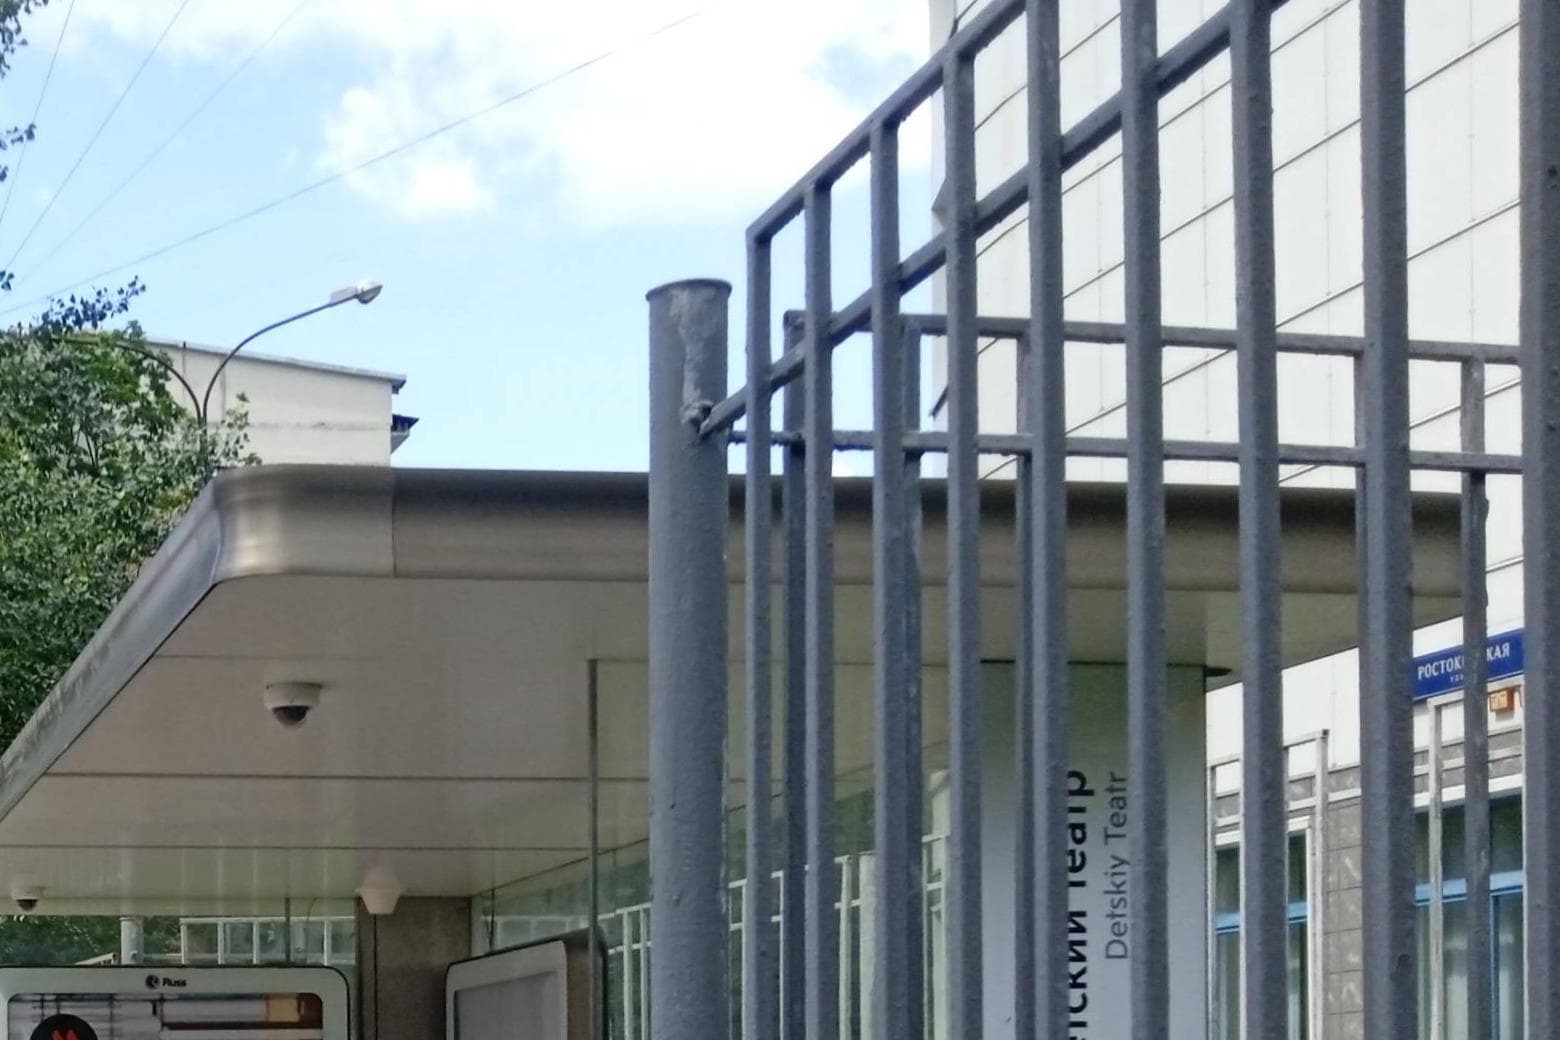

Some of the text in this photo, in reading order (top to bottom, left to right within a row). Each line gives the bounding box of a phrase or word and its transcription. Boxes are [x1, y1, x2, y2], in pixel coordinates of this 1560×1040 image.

[1417, 642, 1511, 681] РОСТОККАЯ
[1104, 771, 1131, 960] Detskiy Teatr
